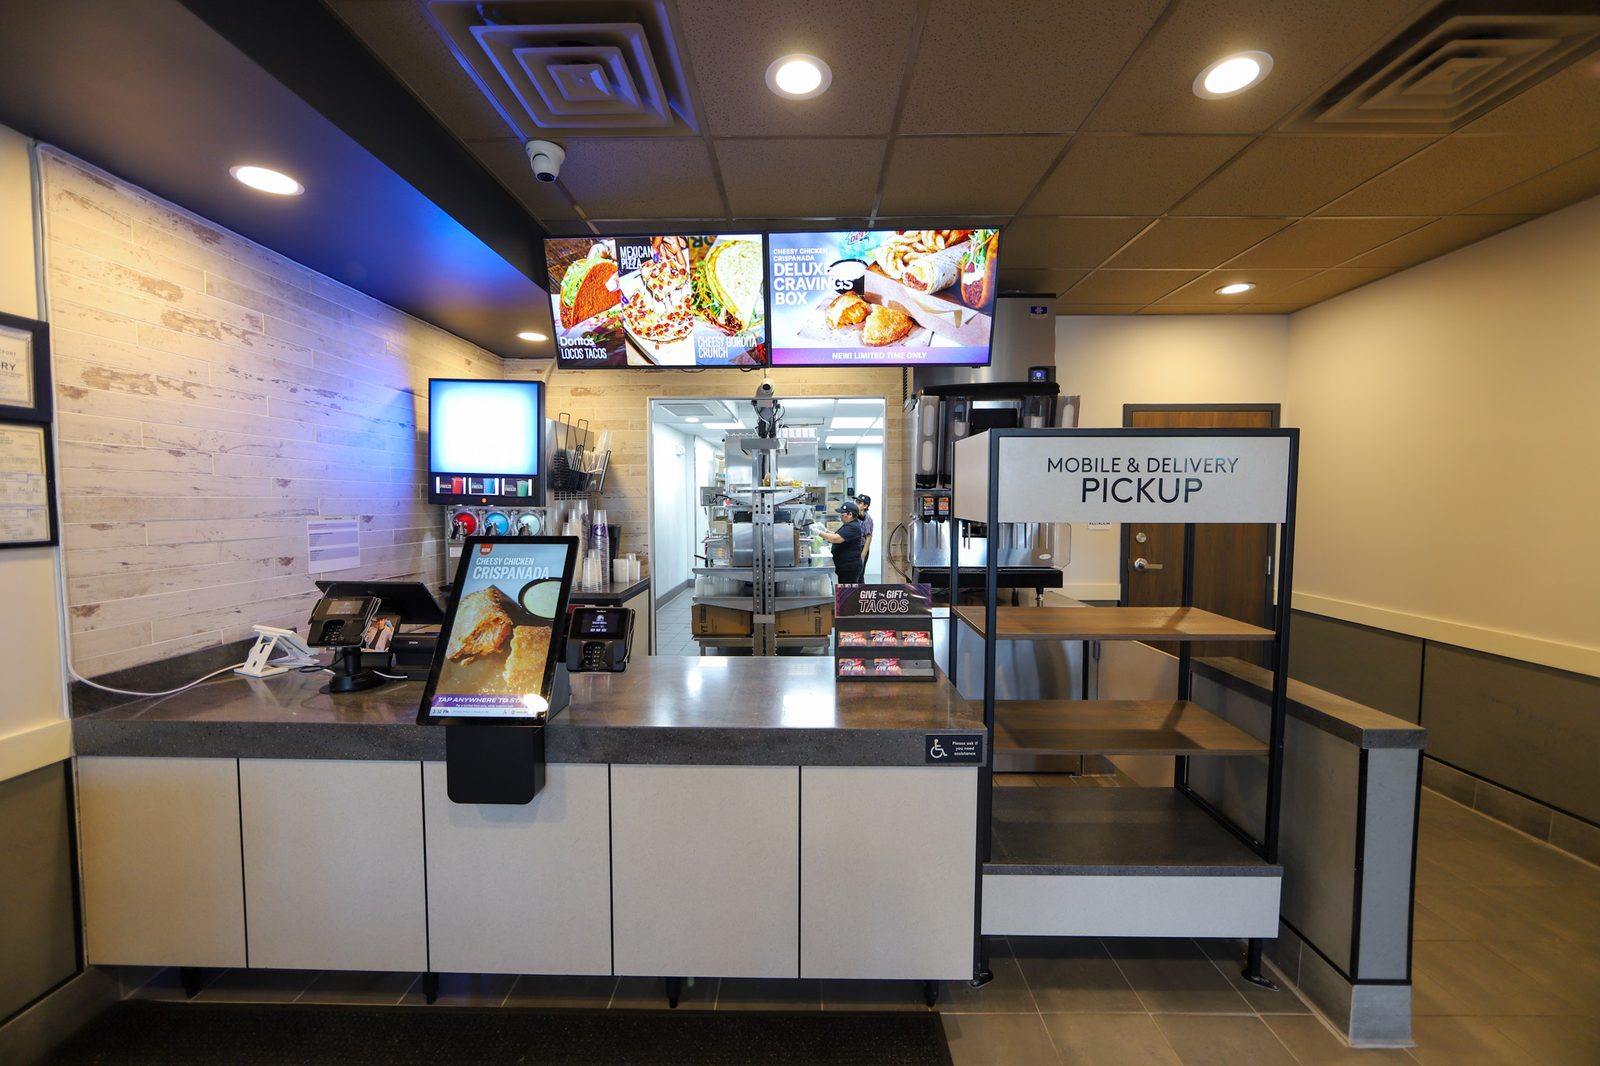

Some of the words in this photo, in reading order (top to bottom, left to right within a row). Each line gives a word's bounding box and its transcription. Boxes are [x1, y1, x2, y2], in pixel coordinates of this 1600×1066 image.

[619, 245, 654, 258] MEXICAN
[799, 247, 829, 255] CHICKEN
[621, 257, 642, 270] PIZZA
[773, 276, 854, 291] CRAVINGS
[774, 291, 808, 305] BOX
[559, 336, 596, 347] Doritos
[697, 336, 725, 348] CHEESY
[726, 335, 758, 348] GORDITA
[561, 347, 584, 360] LOCOS
[584, 347, 608, 360] TACOS
[698, 347, 729, 359] CRUNCH
[832, 352, 852, 360] NEW!
[853, 352, 885, 360] LIMITED
[887, 352, 905, 360] TIME
[906, 352, 928, 360] ONLY
[1047, 457, 1121, 473] MOBILE
[1126, 457, 1140, 473] &
[1147, 457, 1239, 473] DELIVERY
[1081, 477, 1203, 504] PICKUP
[476, 557, 503, 566] CHEESY
[503, 557, 535, 566] CHICKEN
[472, 566, 550, 580] CRISPANADA
[859, 590, 877, 599] GIVE
[886, 590, 904, 599] GIFT
[858, 599, 910, 613] TACOS
